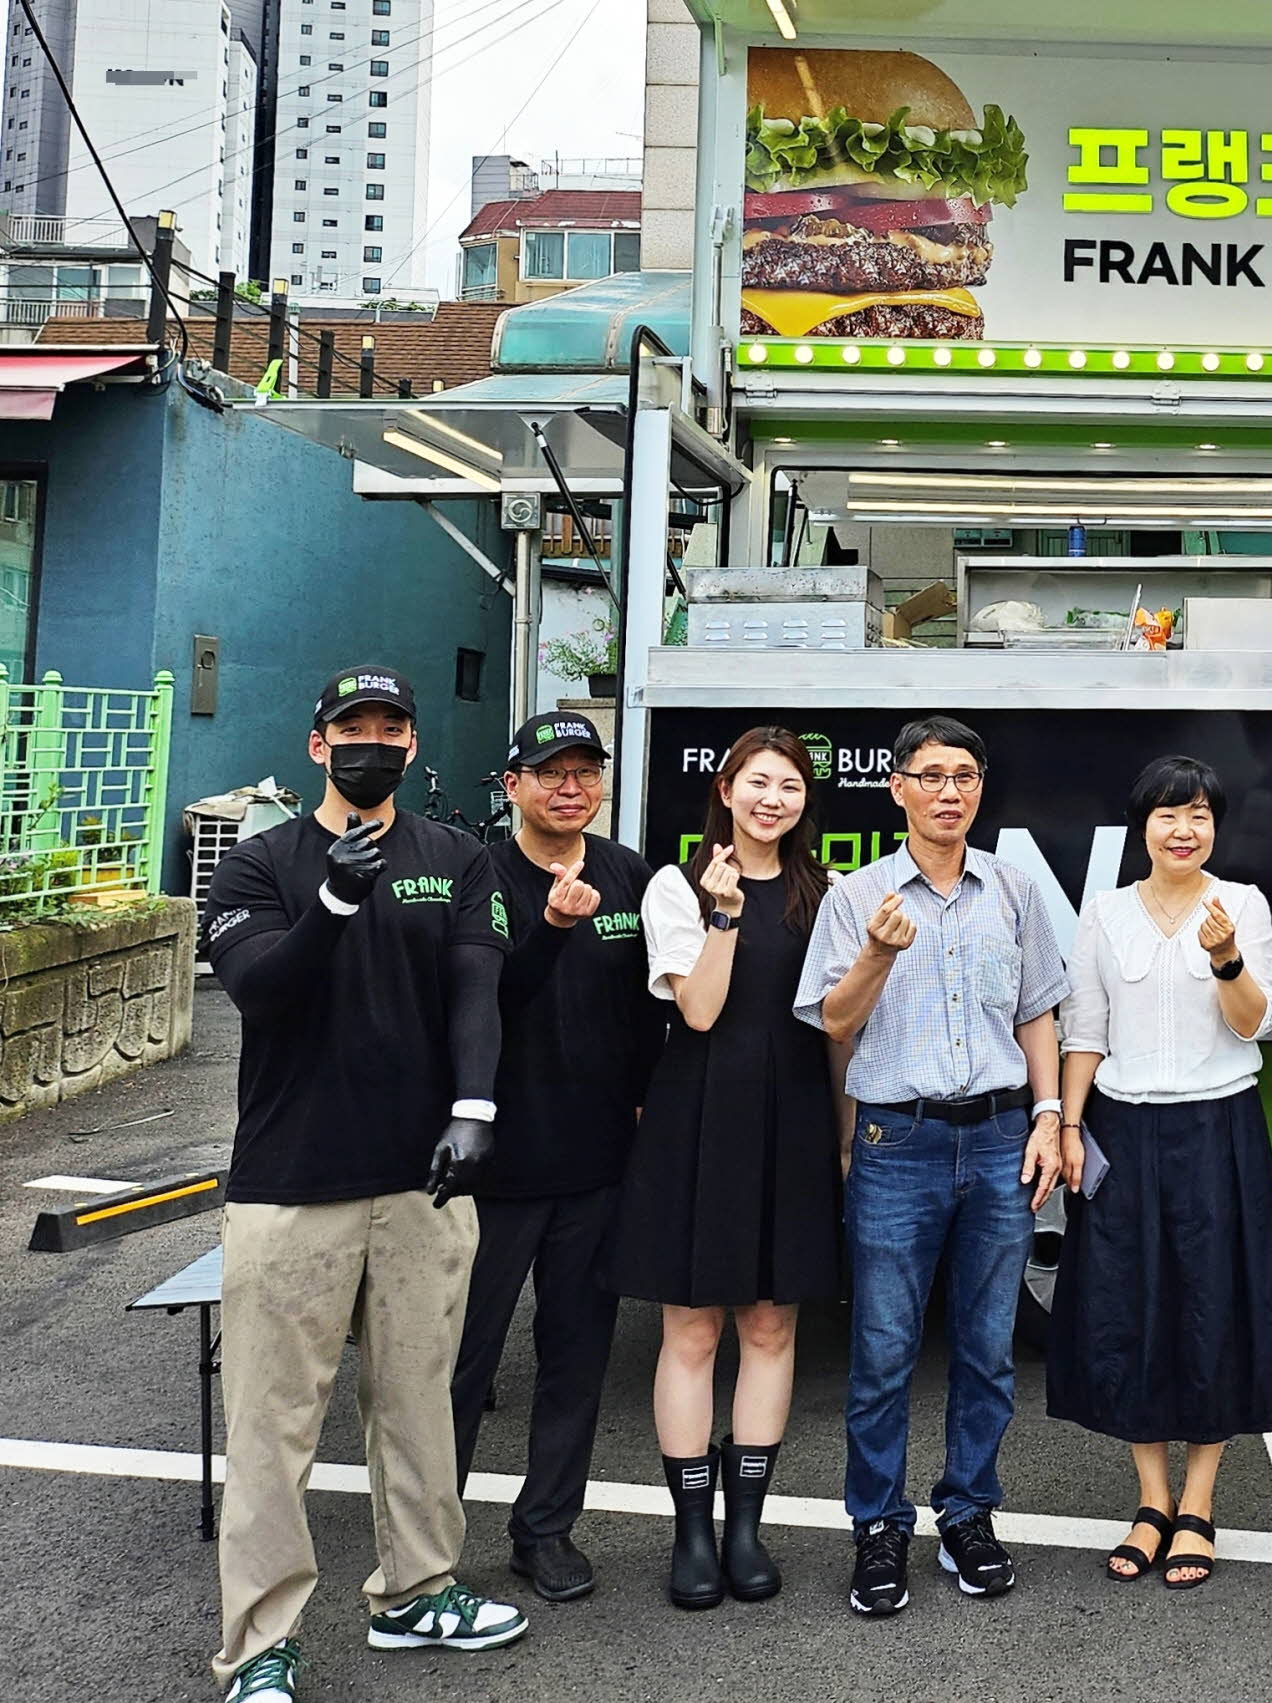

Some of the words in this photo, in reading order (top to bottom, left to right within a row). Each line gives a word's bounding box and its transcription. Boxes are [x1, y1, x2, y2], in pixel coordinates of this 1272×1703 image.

[1063, 238, 1266, 288] FRANK
[358, 675, 396, 685] FRANK
[554, 722, 586, 730] FRANK
[555, 728, 592, 740] BURGER
[837, 748, 897, 773] BUR
[391, 876, 453, 899] FRANK
[592, 912, 640, 935] FRANK
